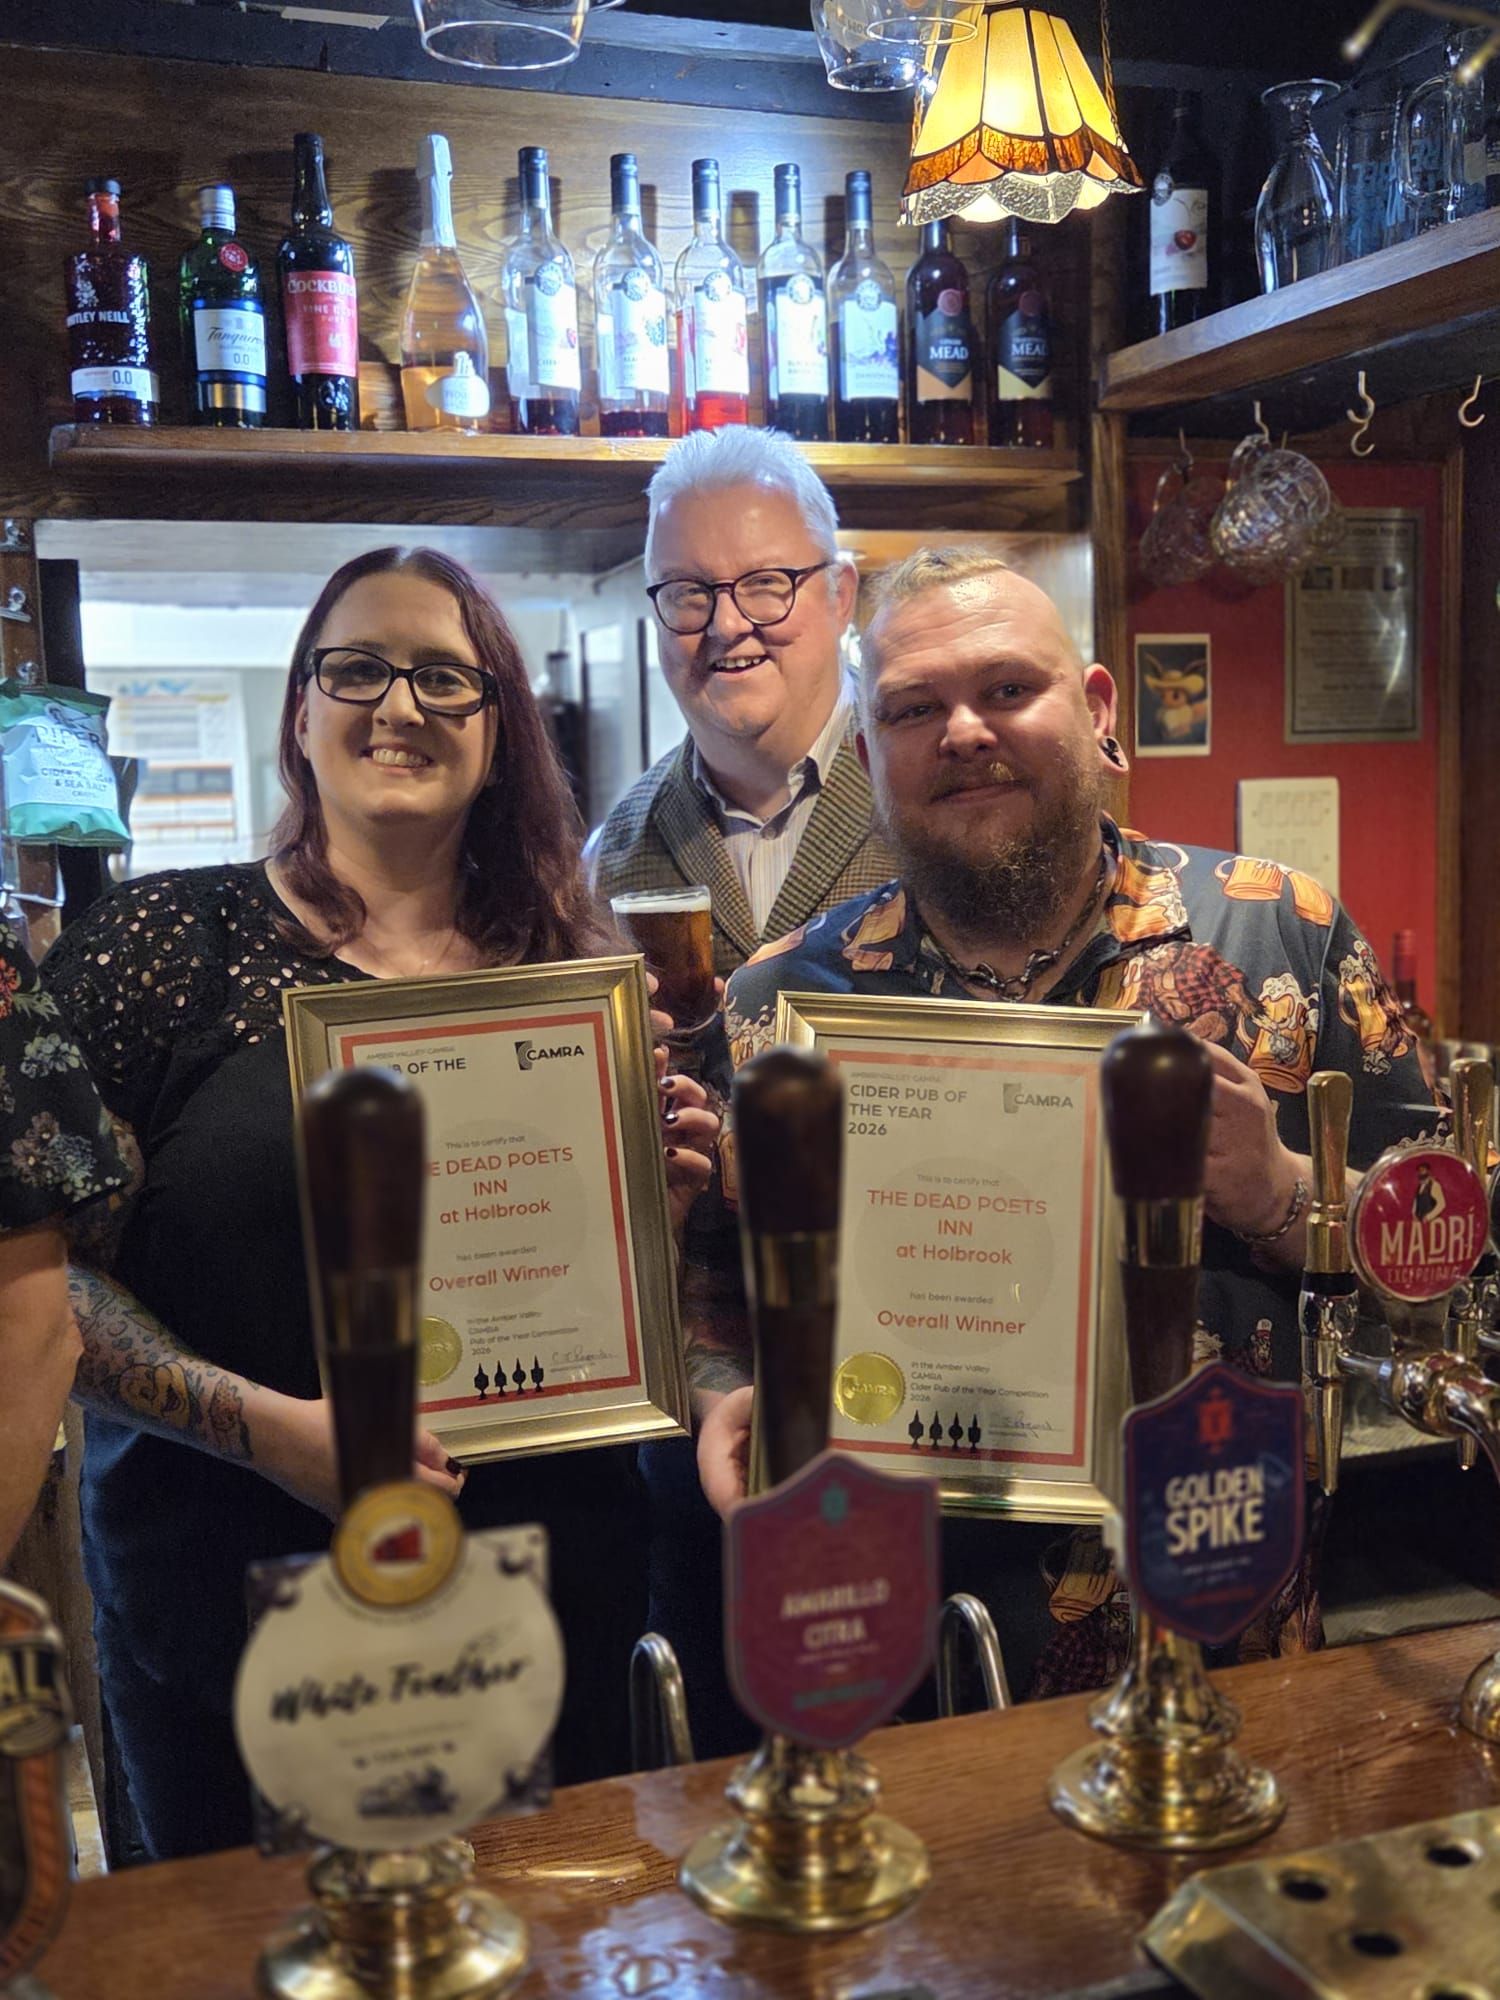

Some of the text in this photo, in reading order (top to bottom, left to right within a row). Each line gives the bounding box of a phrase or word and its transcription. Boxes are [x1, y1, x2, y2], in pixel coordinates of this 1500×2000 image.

[98, 310, 130, 324] NEILL
[929, 345, 969, 360] MEAD
[112, 370, 133, 385] 0.0
[526, 1045, 585, 1061] CAMRA
[407, 1061, 430, 1075] OF
[433, 1058, 467, 1072] THE
[850, 1084, 968, 1103] CIDER PUB OF
[1014, 1093, 1074, 1109] CAMRA
[849, 1103, 932, 1120] THE YEAR
[847, 1122, 887, 1136] 2026
[446, 1154, 502, 1175] DEAD
[508, 1147, 574, 1168] POETS
[473, 1179, 508, 1196] INN
[867, 1189, 1047, 1215] THE DEAD POETS
[440, 1199, 552, 1224] at Holbrook
[938, 1219, 973, 1236] INN
[896, 1243, 1013, 1265] at Holbrook
[429, 1264, 570, 1291] Overall Winner
[928, 1292, 952, 1301] been
[877, 1310, 1026, 1334] Overall Winner
[920, 1361, 933, 1369] the
[935, 1362, 963, 1371] Amber
[965, 1364, 990, 1374] Valley
[933, 1384, 950, 1393] Pub
[951, 1385, 961, 1394] of
[962, 1386, 974, 1394] the
[976, 1387, 997, 1396] Year
[1165, 1463, 1265, 1509] GOLDEN
[1165, 1498, 1266, 1557] SPIKE
[803, 1616, 867, 1650] CITRA
[269, 1653, 529, 1725] White Feather
